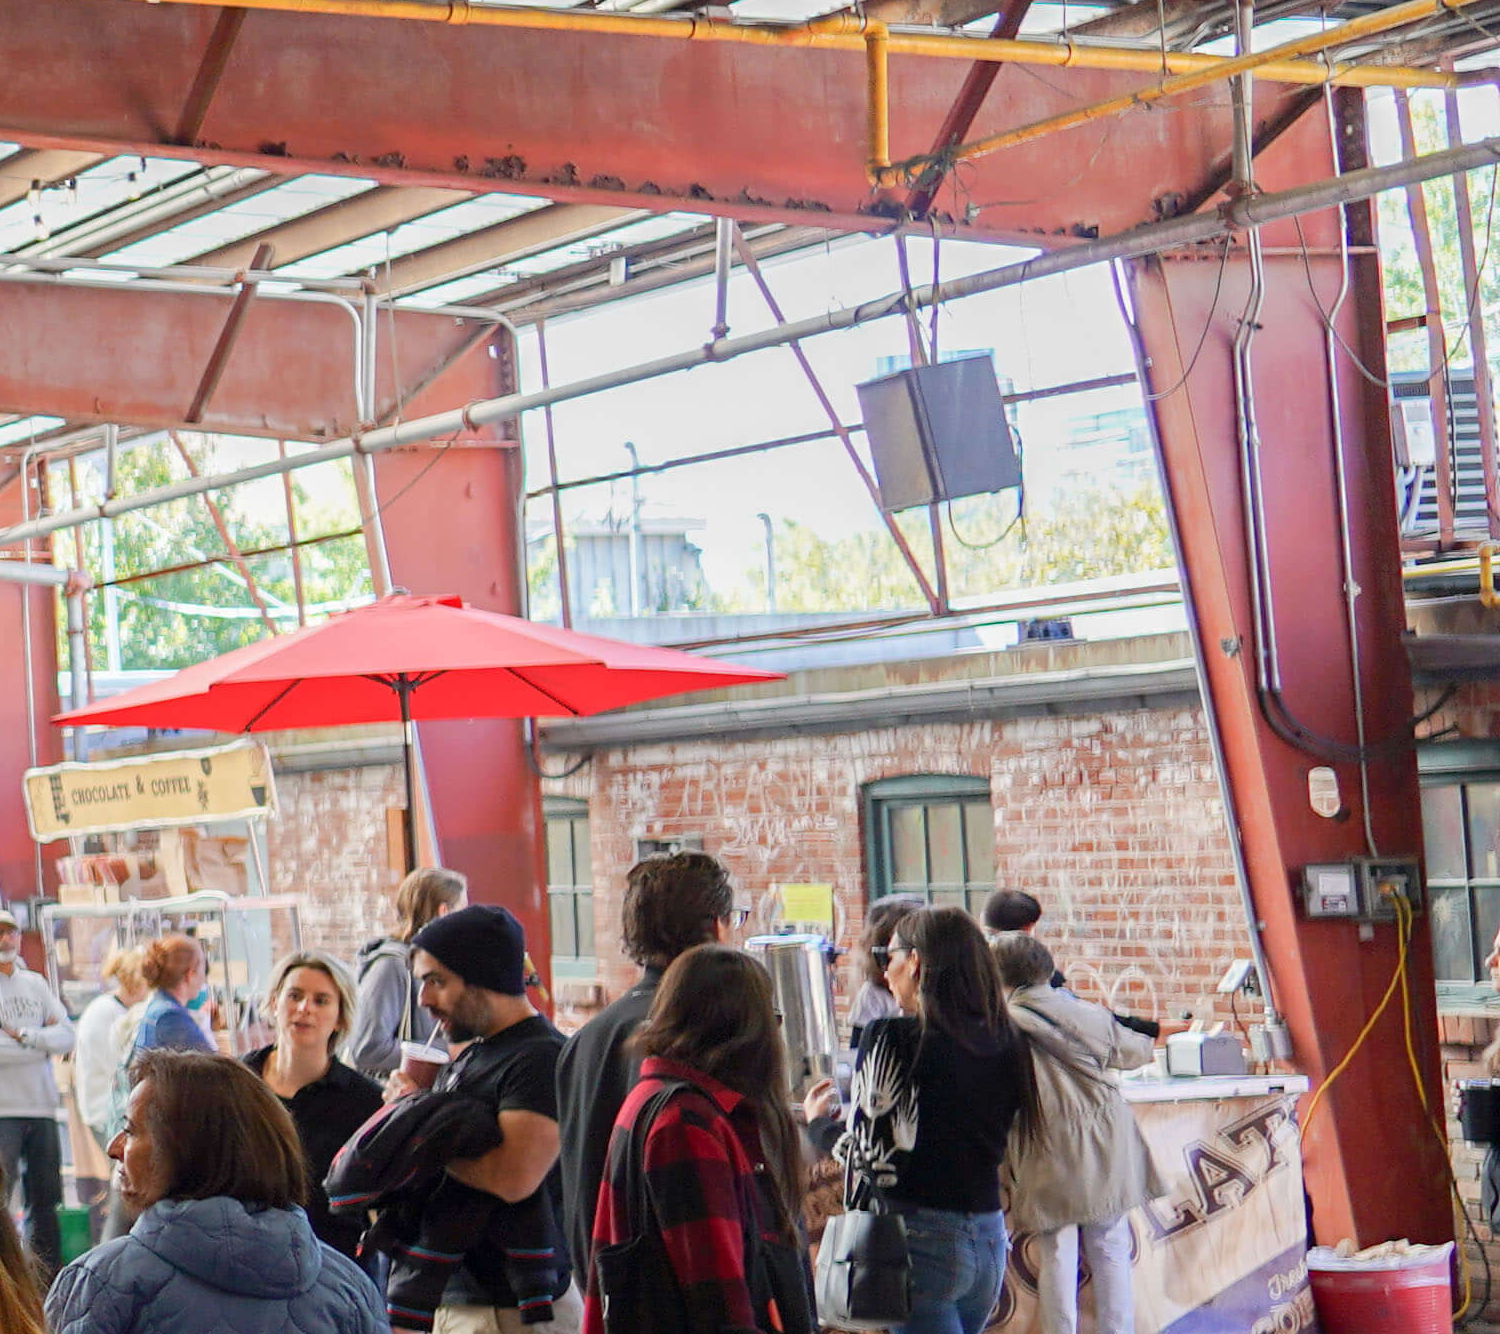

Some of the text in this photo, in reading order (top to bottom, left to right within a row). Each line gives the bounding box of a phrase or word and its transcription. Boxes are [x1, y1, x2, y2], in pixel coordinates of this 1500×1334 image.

[70, 774, 192, 805] CHOCOLATE & COFFEE
